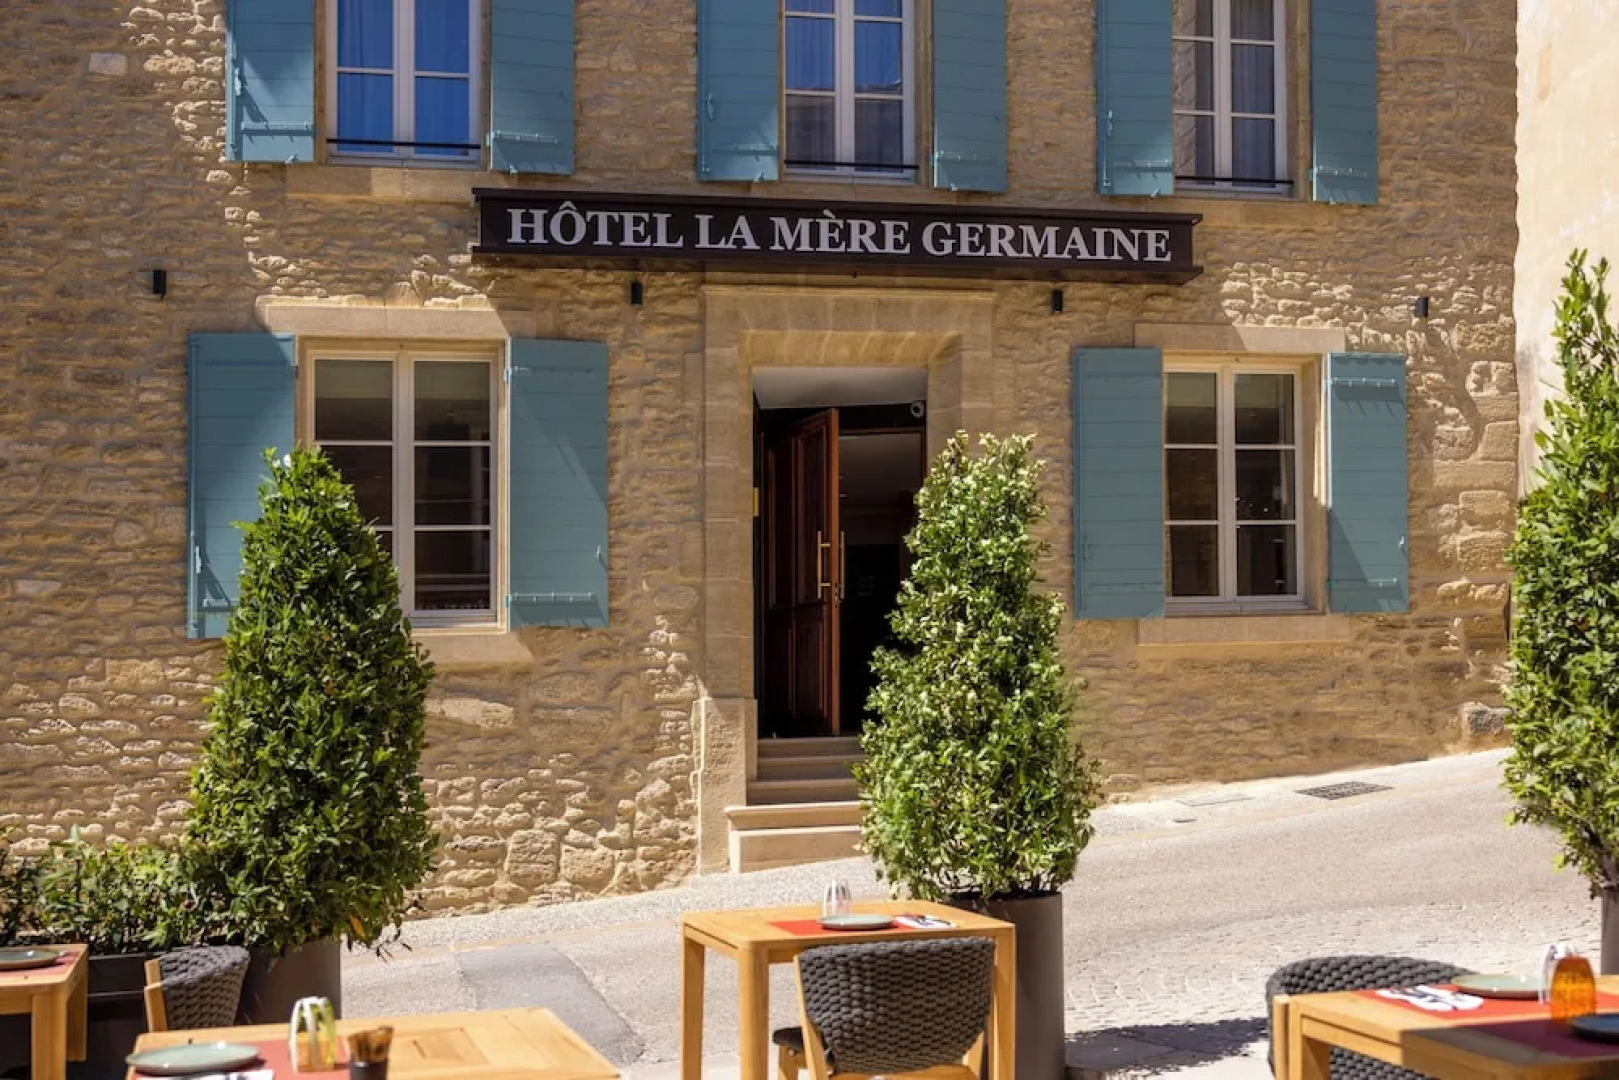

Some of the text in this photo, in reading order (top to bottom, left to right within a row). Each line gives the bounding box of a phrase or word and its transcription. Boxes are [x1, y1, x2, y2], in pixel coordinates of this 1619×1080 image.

[507, 201, 1172, 262] HÔTEL LA MÈRE GERMAINE
